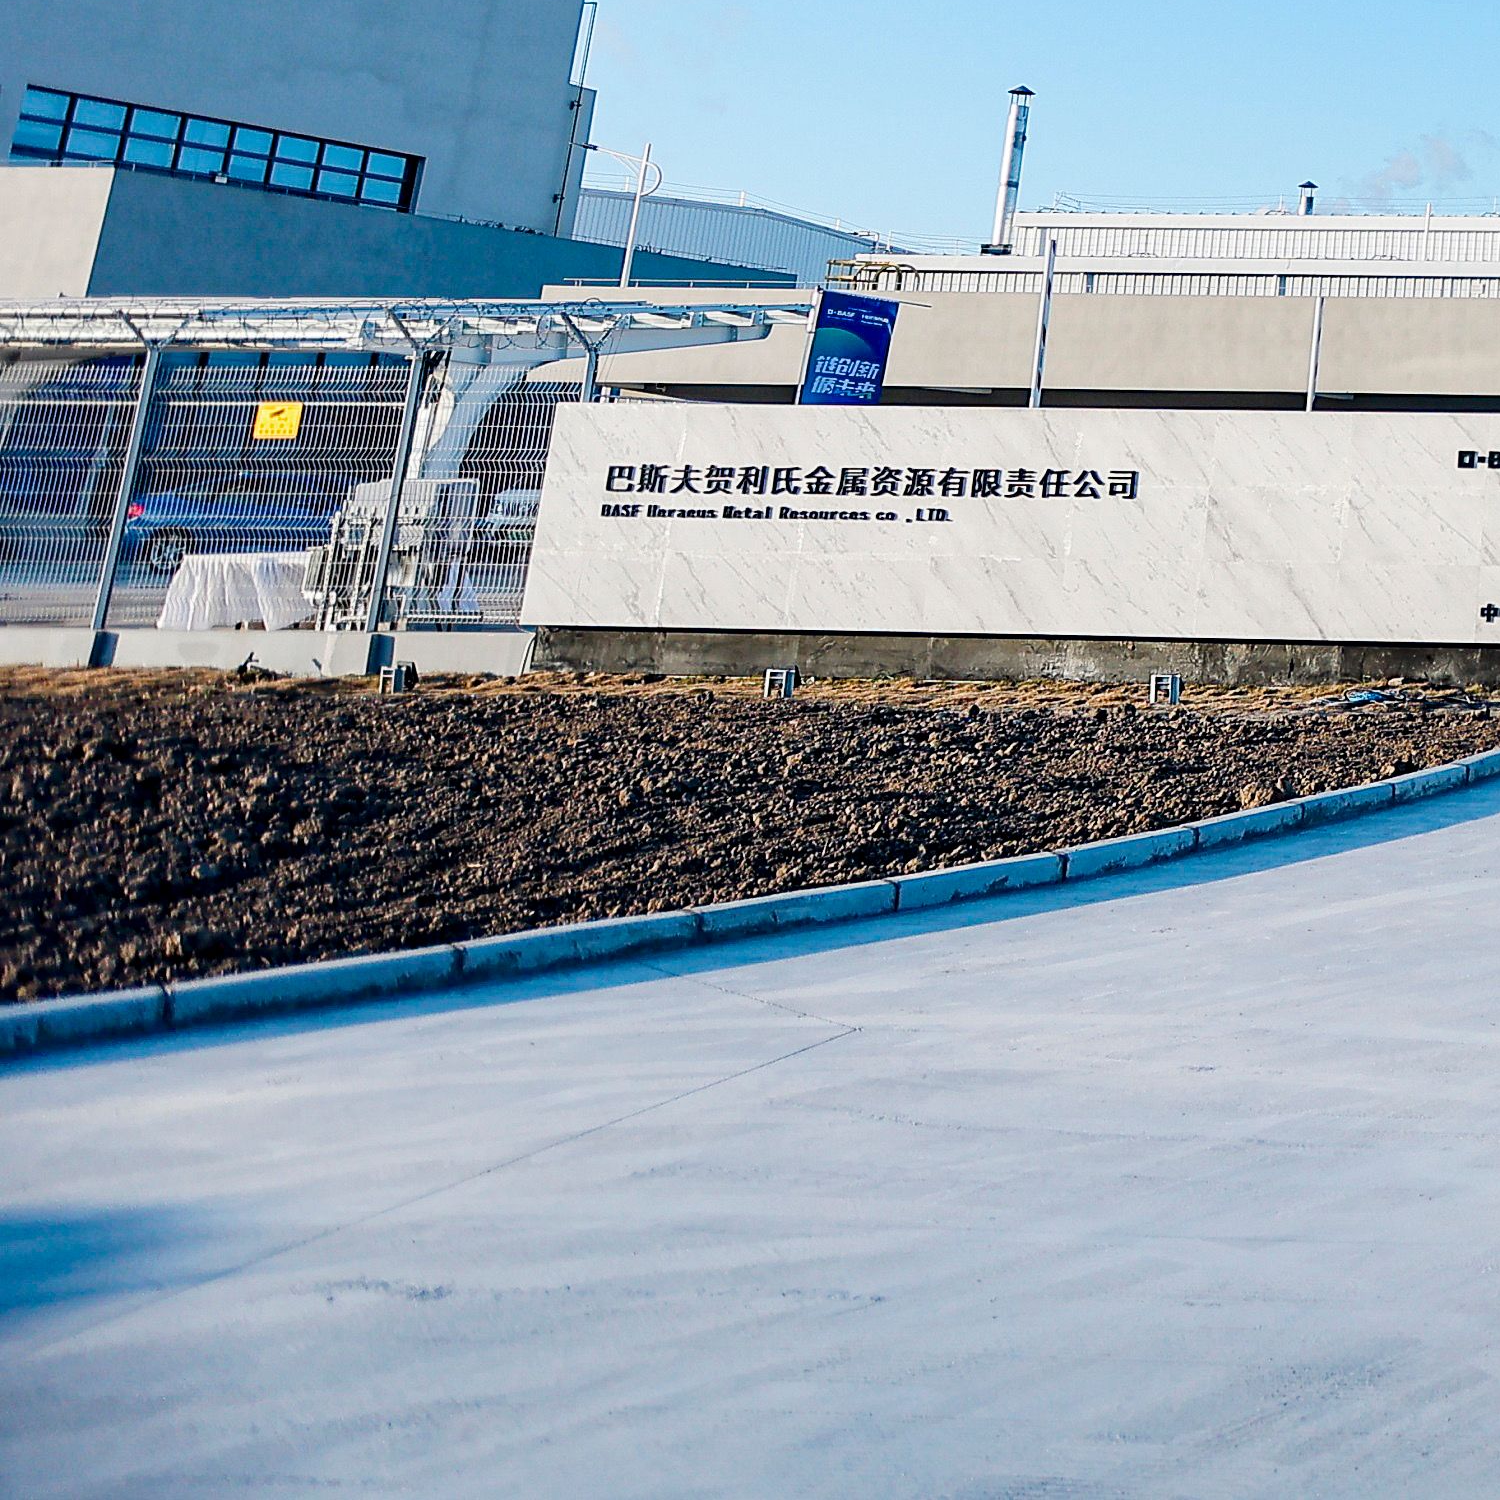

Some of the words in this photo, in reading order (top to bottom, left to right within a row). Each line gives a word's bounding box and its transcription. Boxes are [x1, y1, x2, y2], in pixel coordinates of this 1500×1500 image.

[815, 356, 880, 379] 链创新
[605, 464, 1140, 499] 巴斯夫贺利氏金属资源有限责任公司
[601, 504, 643, 517] BASF
[779, 507, 869, 521] Resources
